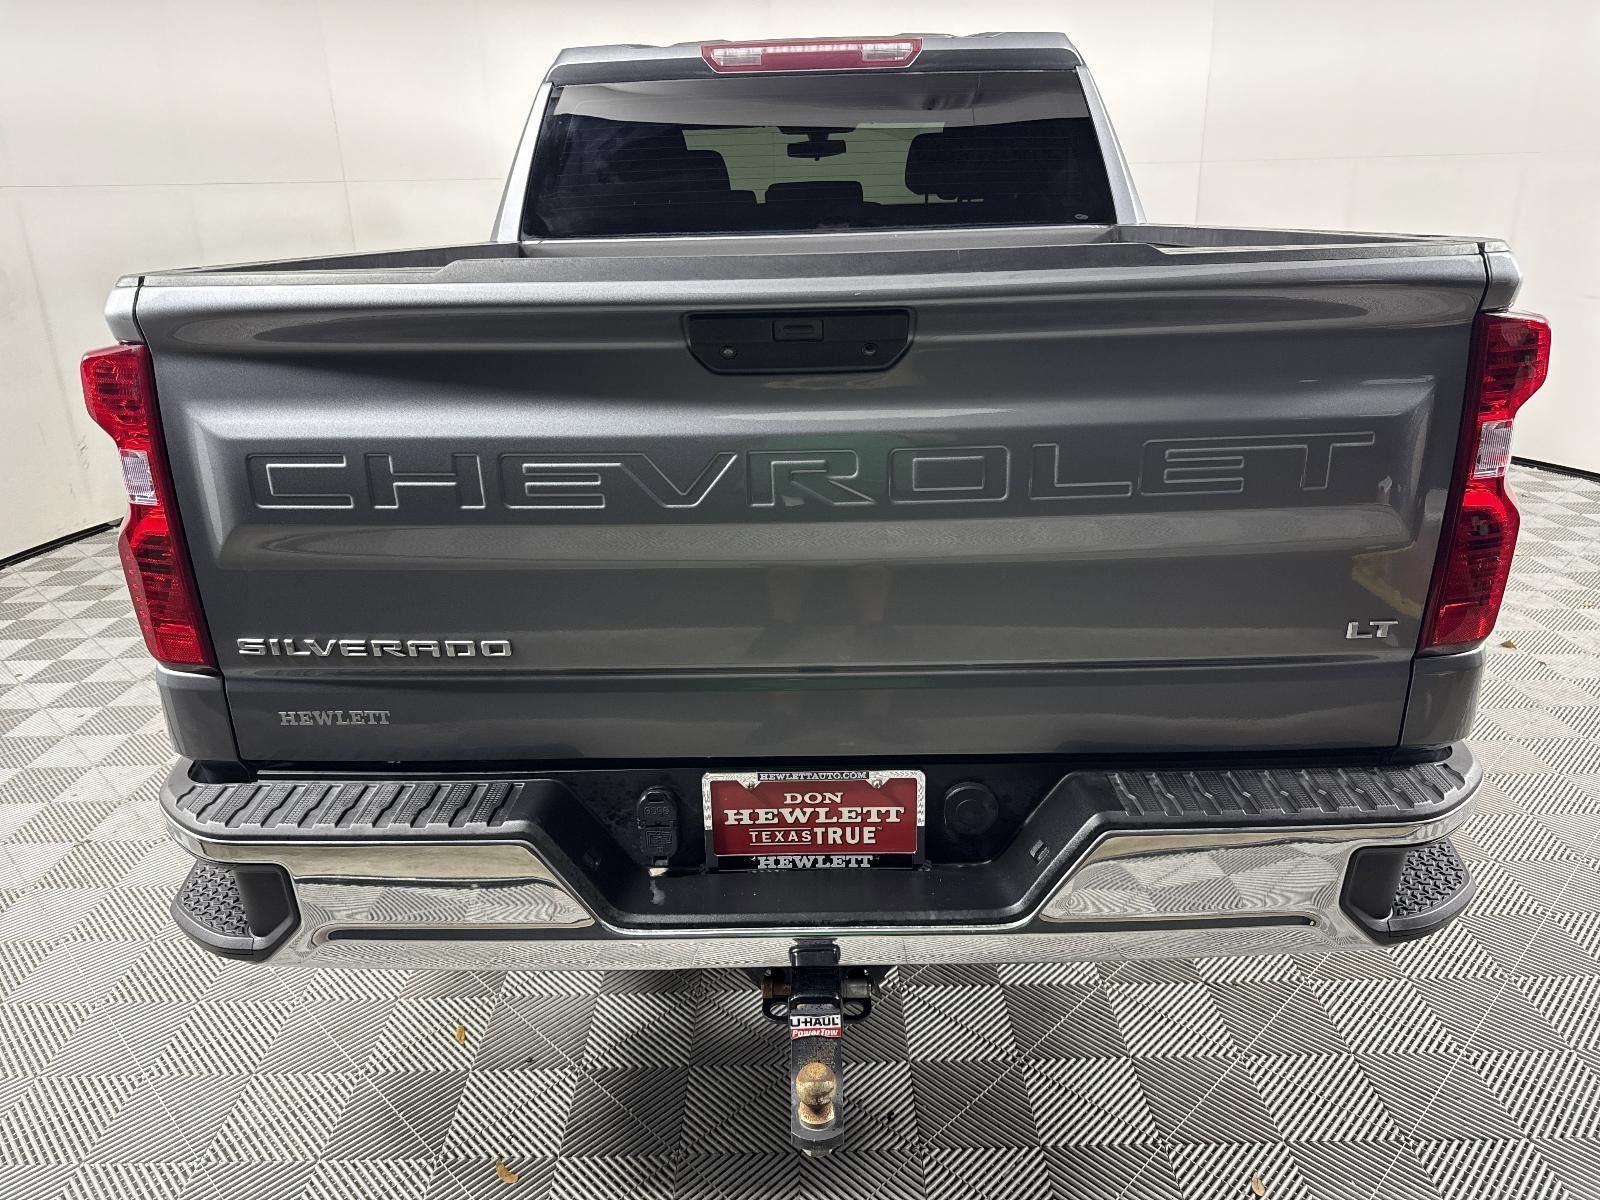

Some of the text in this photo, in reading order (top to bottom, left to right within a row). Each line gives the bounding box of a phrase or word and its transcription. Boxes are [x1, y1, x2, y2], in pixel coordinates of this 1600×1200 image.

[246, 431, 1375, 509] CHEVROLET
[1345, 620, 1399, 639] LT
[236, 637, 513, 658] SILVERADO
[277, 709, 391, 726] HEWLETT
[759, 771, 868, 781] HEWLETTAUTO.COM
[783, 791, 844, 804] DON
[723, 806, 905, 825] HEWLETT
[757, 854, 874, 869] HEWLETT
